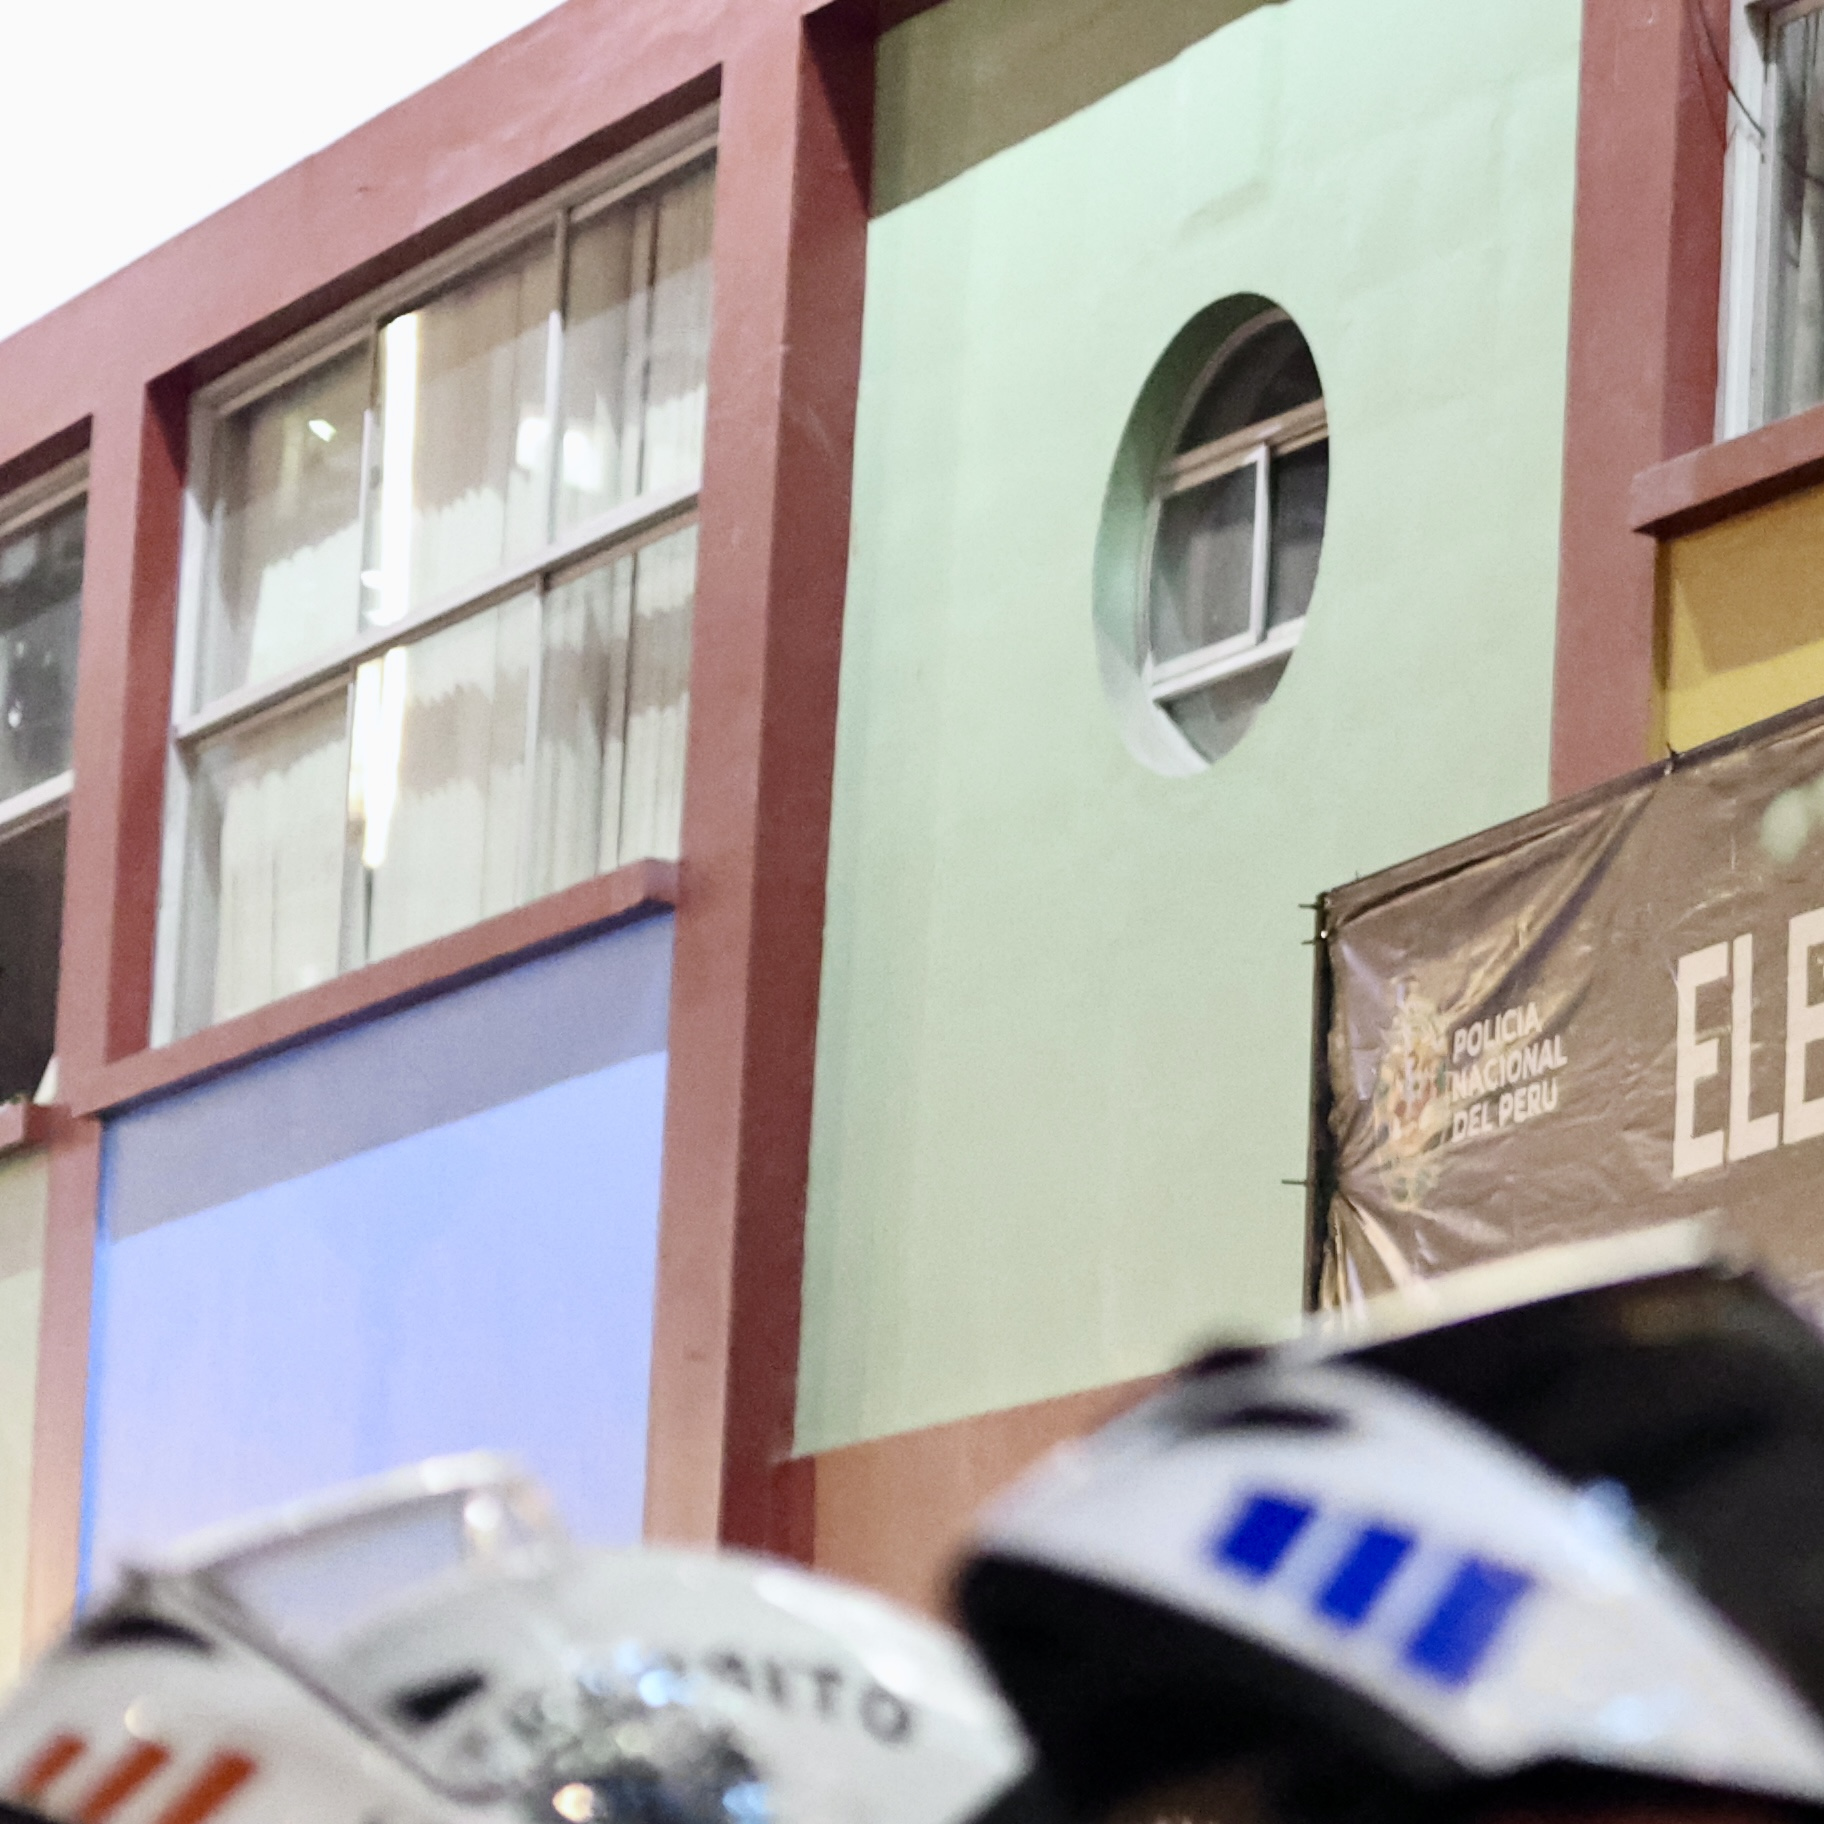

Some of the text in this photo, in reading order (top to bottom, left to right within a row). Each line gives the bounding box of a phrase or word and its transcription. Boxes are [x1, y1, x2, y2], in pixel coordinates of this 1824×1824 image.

[1453, 1001, 1542, 1064] POLICIA
[1451, 1034, 1568, 1101] NACIONAL
[1452, 1101, 1493, 1143] DEL
